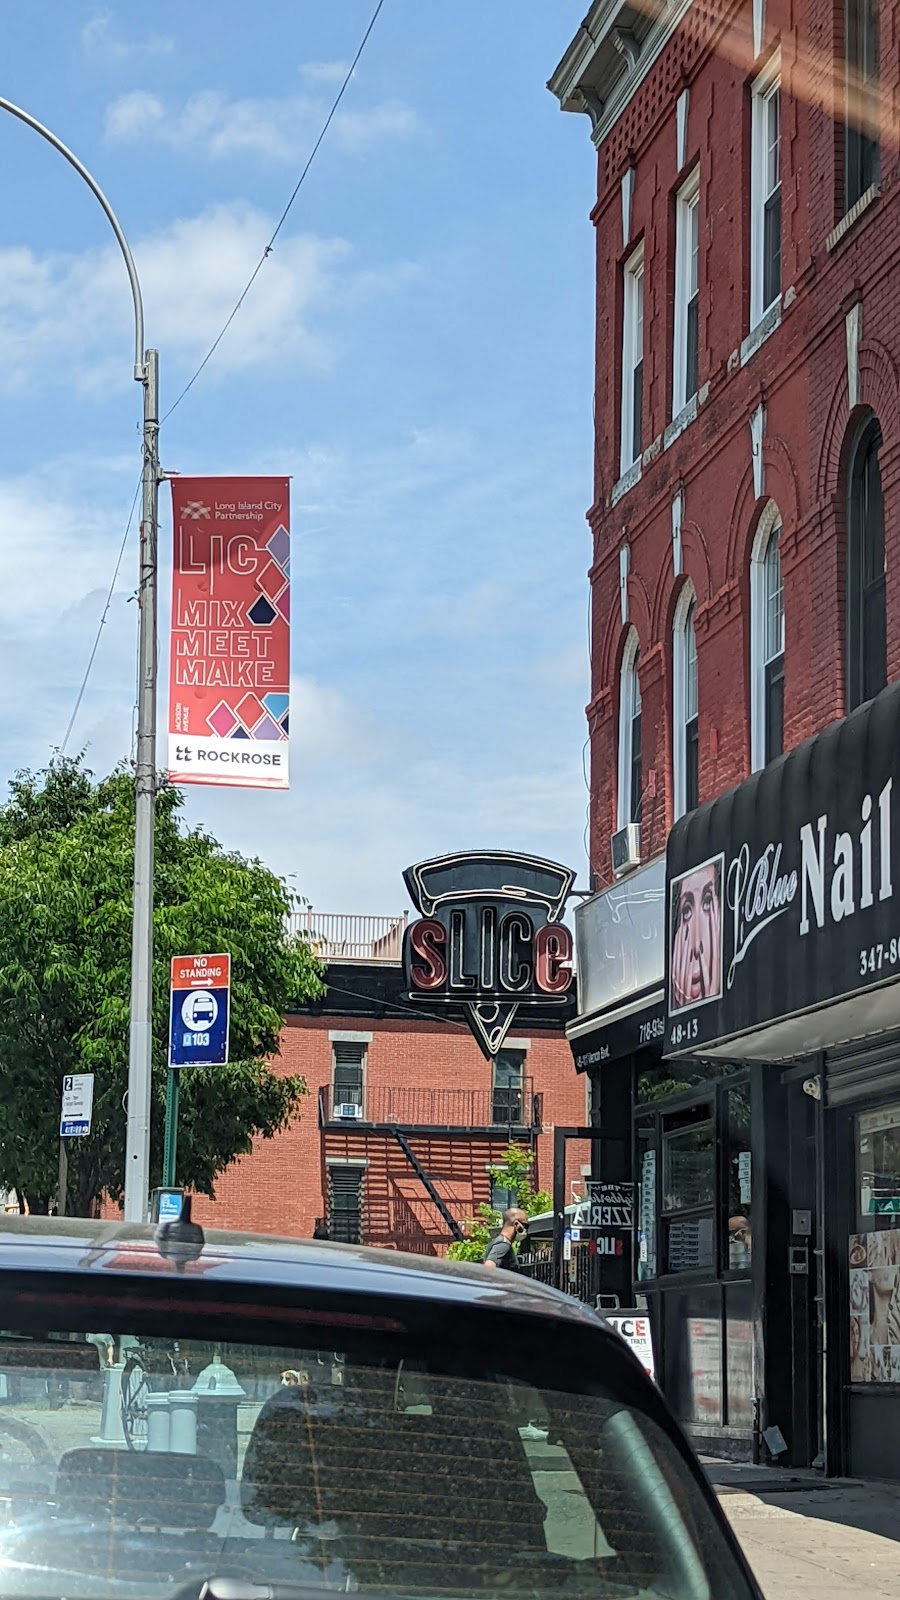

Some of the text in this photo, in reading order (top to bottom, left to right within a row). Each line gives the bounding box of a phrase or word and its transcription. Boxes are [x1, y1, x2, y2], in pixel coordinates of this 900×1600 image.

[215, 501, 282, 512] Long Island City
[215, 511, 264, 521] Partnership
[180, 526, 258, 595] LIC
[178, 588, 245, 627] MIX
[175, 630, 273, 658] MEET
[176, 659, 276, 688] MAKE
[197, 750, 282, 766] ROCKROSE
[745, 843, 797, 922] Blue
[800, 777, 892, 936] Nail
[180, 967, 222, 979] STANDING
[193, 958, 208, 968] NO
[671, 1018, 699, 1045] 48-13
[65, 1078, 72, 1091] 2
